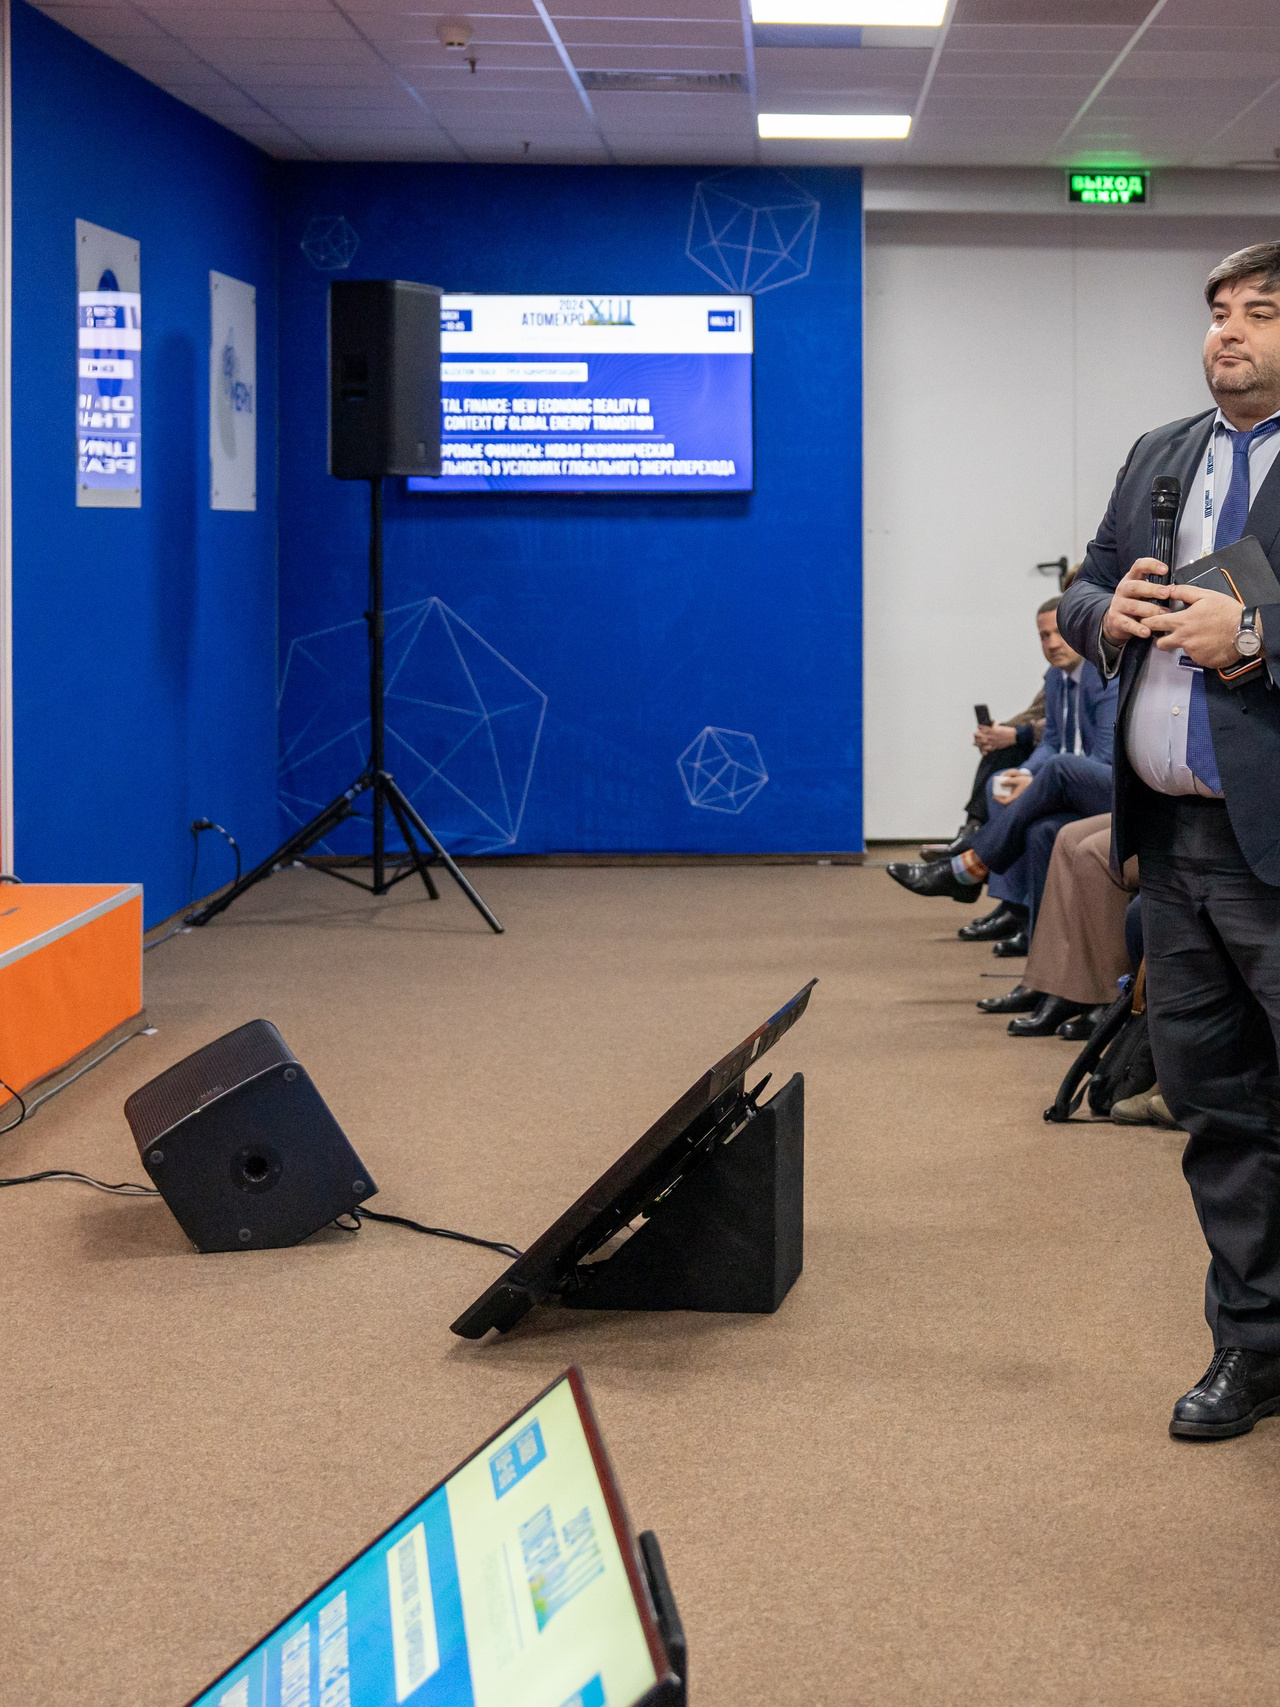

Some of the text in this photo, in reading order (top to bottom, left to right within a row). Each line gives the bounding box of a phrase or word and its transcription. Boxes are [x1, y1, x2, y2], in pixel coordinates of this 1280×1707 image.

[521, 312, 585, 326] ATOMEXPO
[463, 397, 511, 414] FINANCE:
[444, 415, 491, 432] CONTEXT
